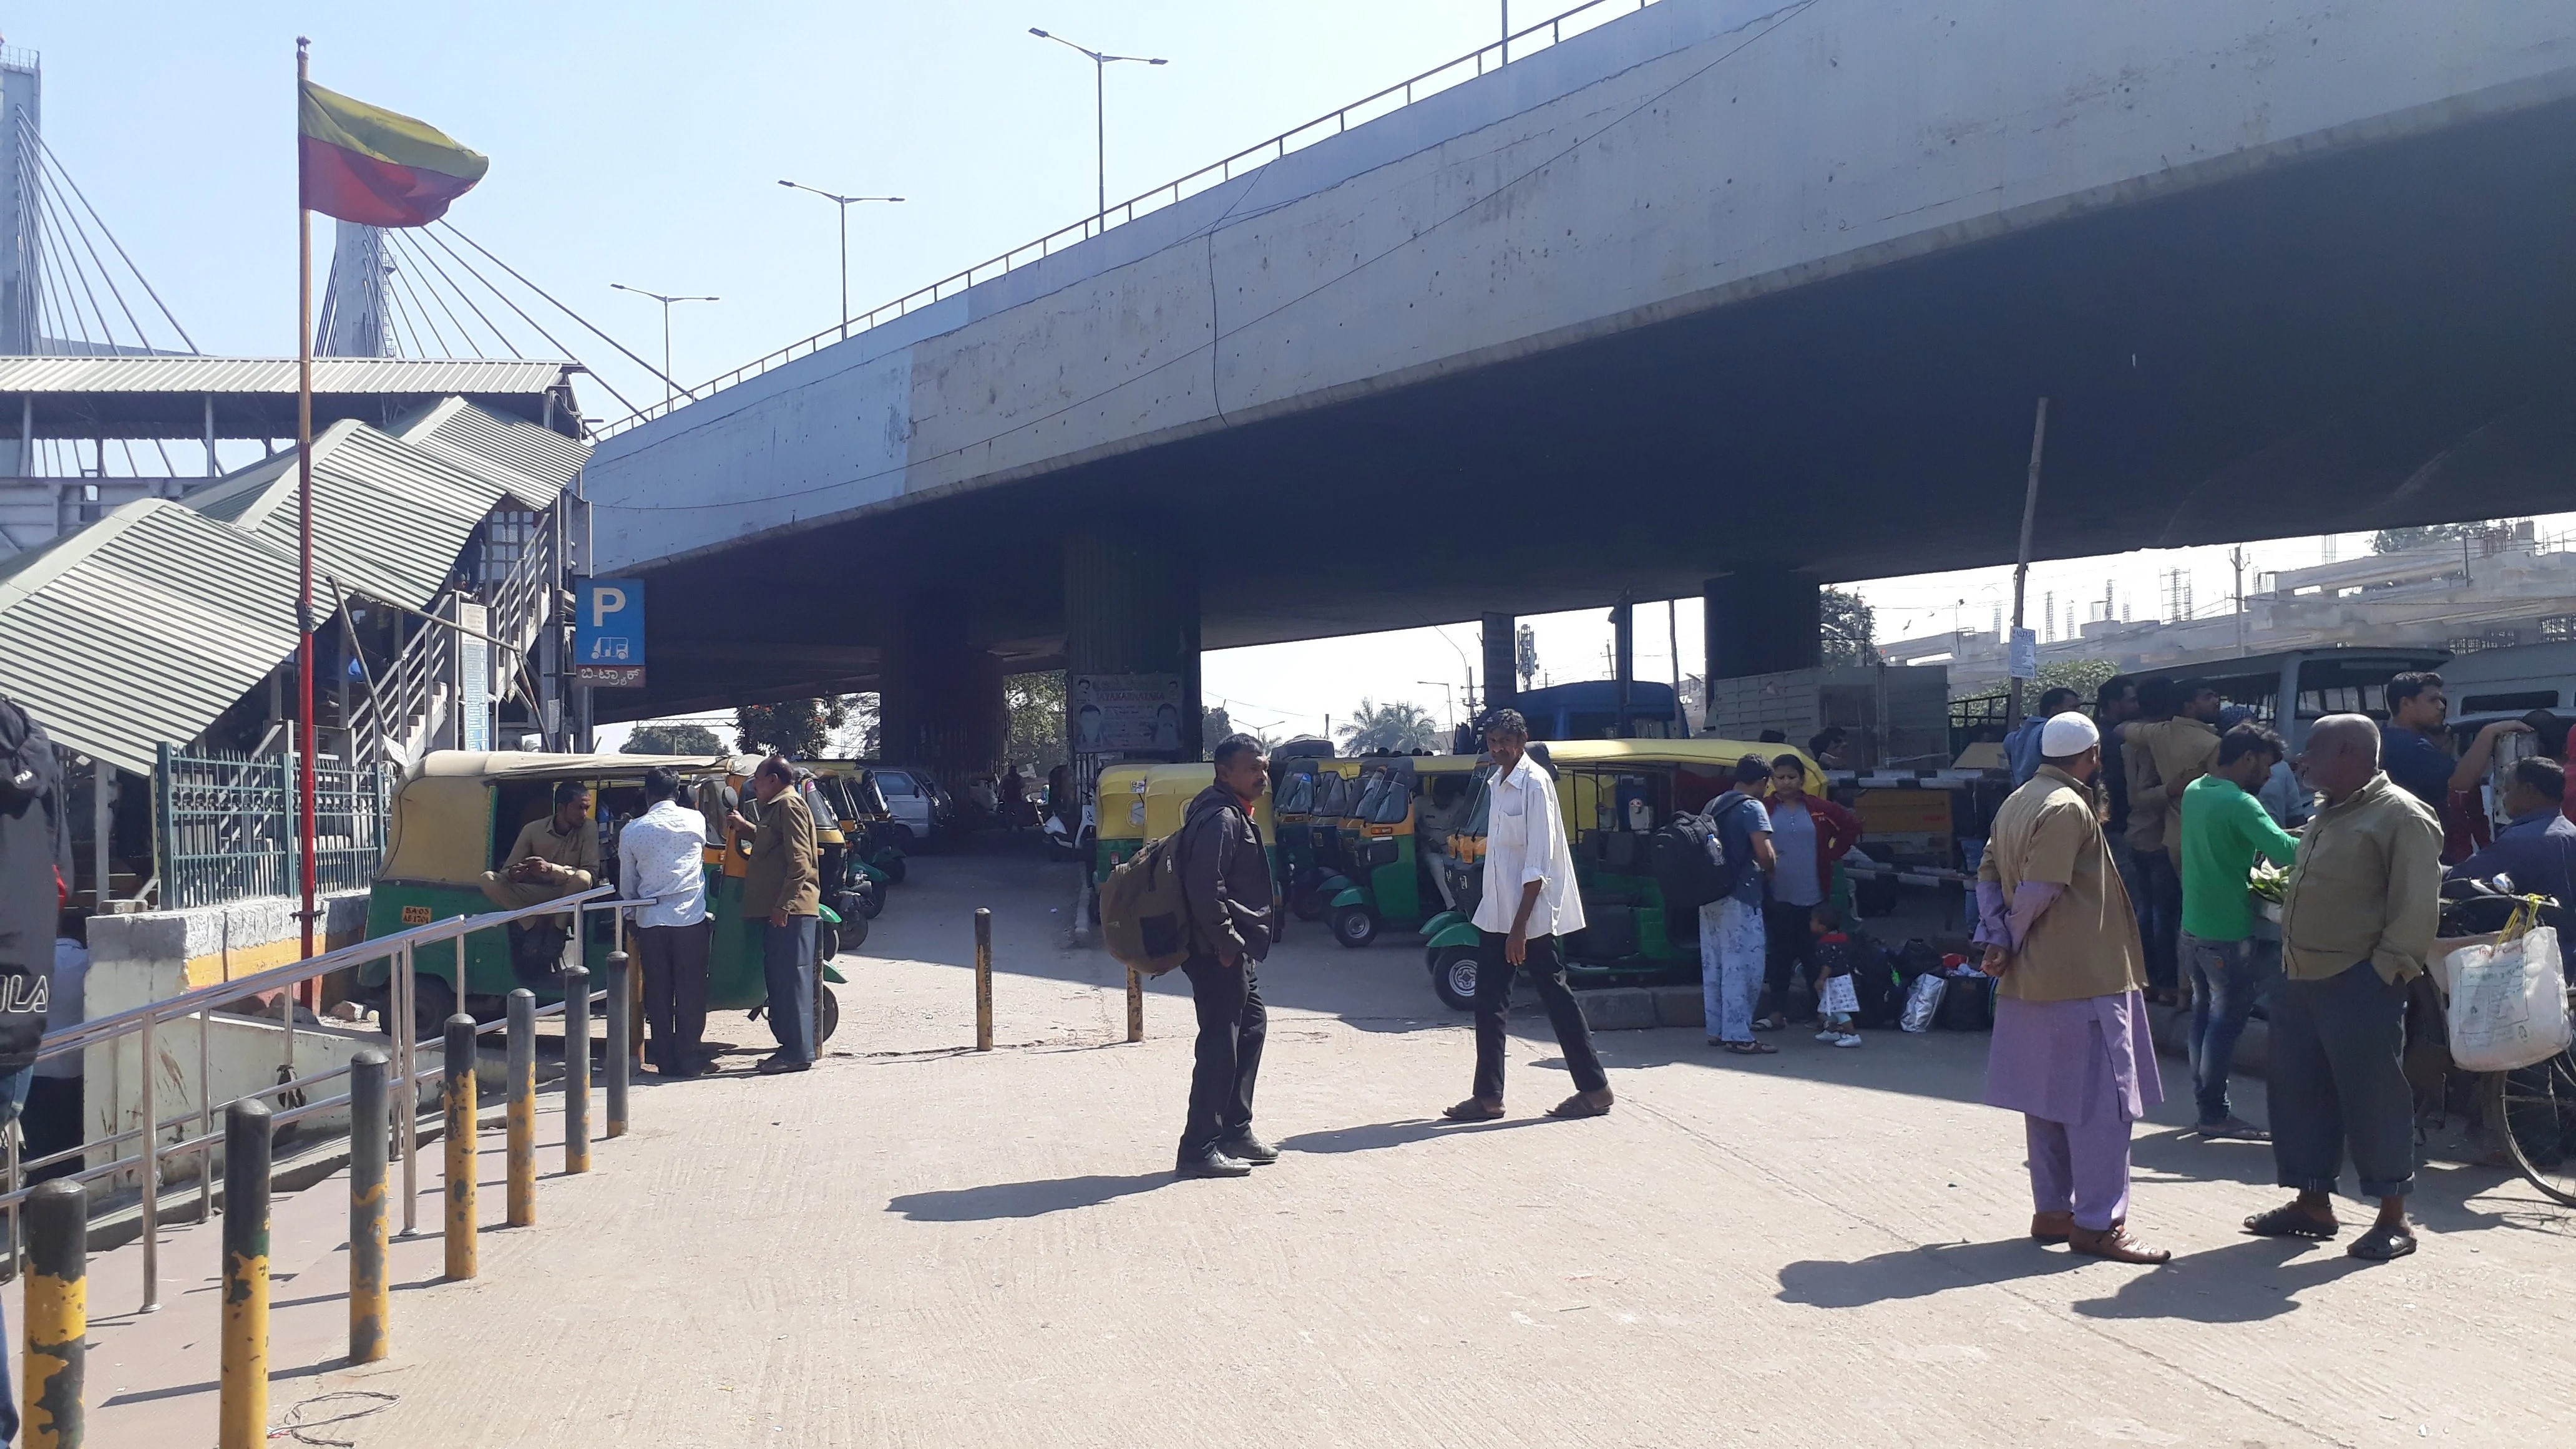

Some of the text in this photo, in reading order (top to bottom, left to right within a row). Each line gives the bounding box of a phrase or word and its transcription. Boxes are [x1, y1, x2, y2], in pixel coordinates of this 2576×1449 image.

[593, 587, 626, 627] P
[14, 770, 32, 784] FILA
[0, 974, 49, 1013] ILA
